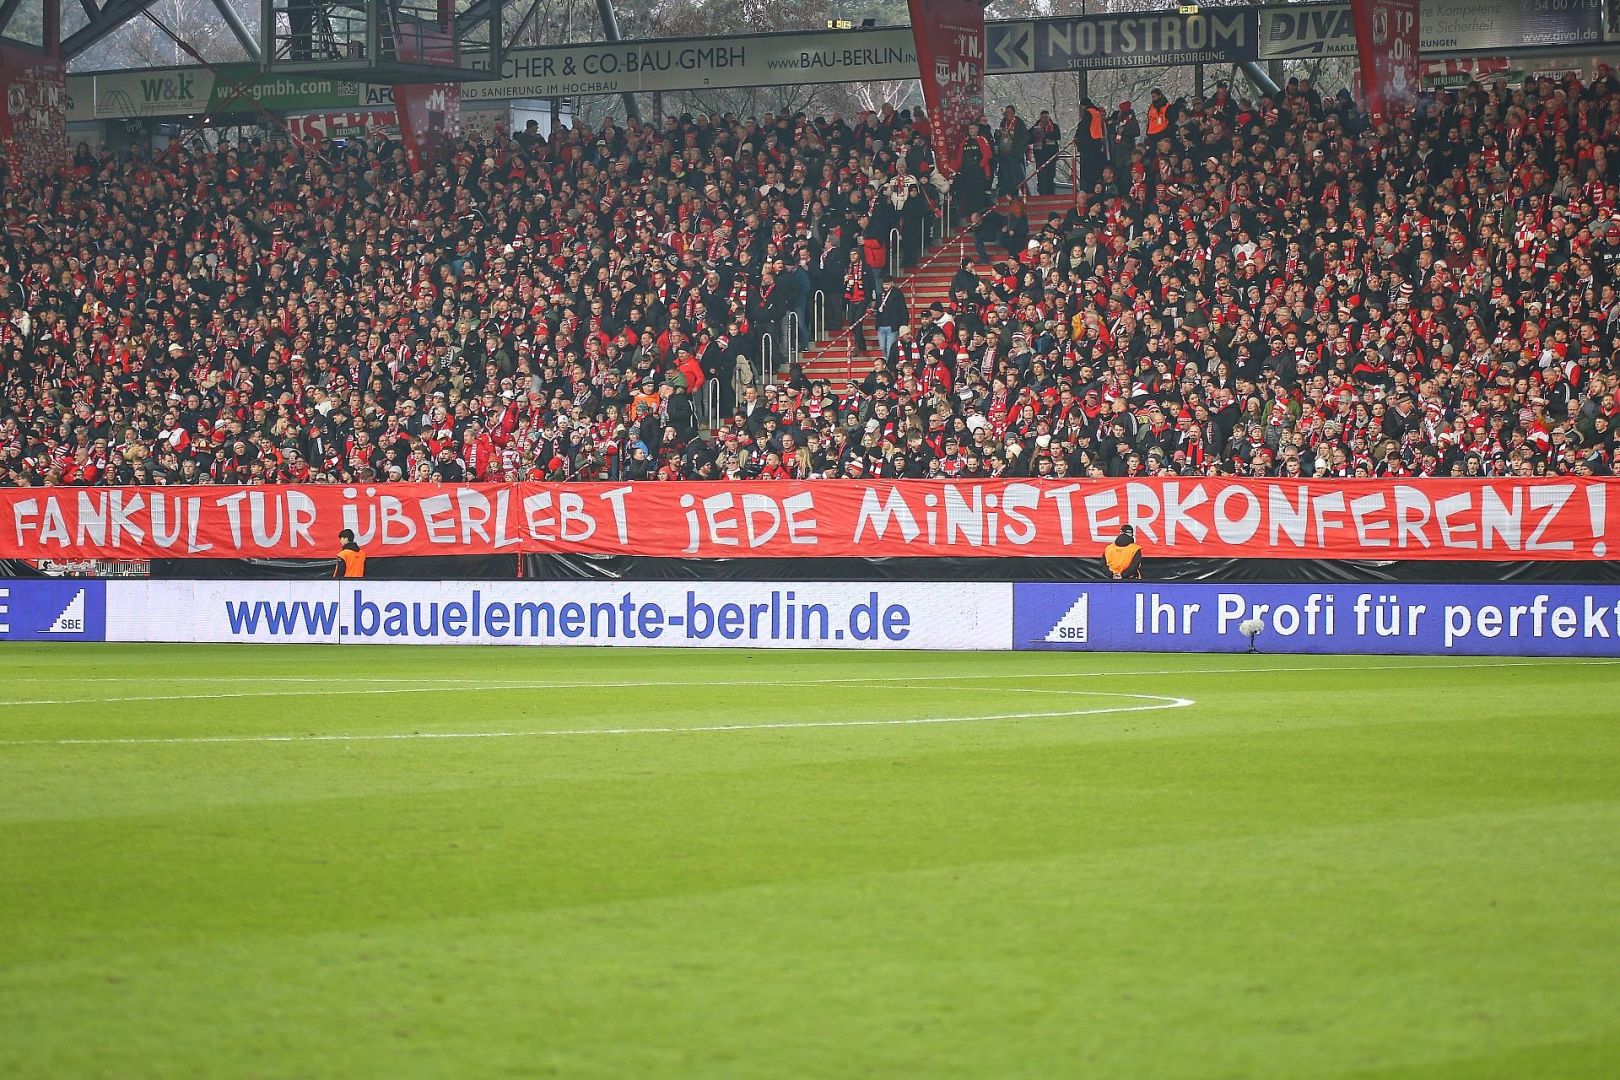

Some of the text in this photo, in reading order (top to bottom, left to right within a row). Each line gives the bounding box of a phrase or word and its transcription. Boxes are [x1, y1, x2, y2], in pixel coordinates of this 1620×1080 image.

[1270, 10, 1355, 41] DIVA
[1438, 19, 1493, 34] Sicherheit
[1049, 13, 1245, 57] NOTSTROM
[1521, 27, 1598, 43] www.dival.de
[1327, 42, 1356, 53] MAKLE
[562, 56, 576, 76] &
[1067, 51, 1225, 68] SICHERHEITSSTROMVERSORGUNG
[461, 81, 618, 98] ND SANIERUNG IM HOCHBAU
[12, 489, 317, 554] FANKULTUR
[226, 590, 911, 641] www.bauelemente-berlin.de
[1135, 593, 1201, 635] Ihr
[1217, 593, 1335, 636] Profi
[1353, 594, 1427, 637] für
[61, 619, 82, 630] SBE
[1059, 627, 1084, 639] SBE
